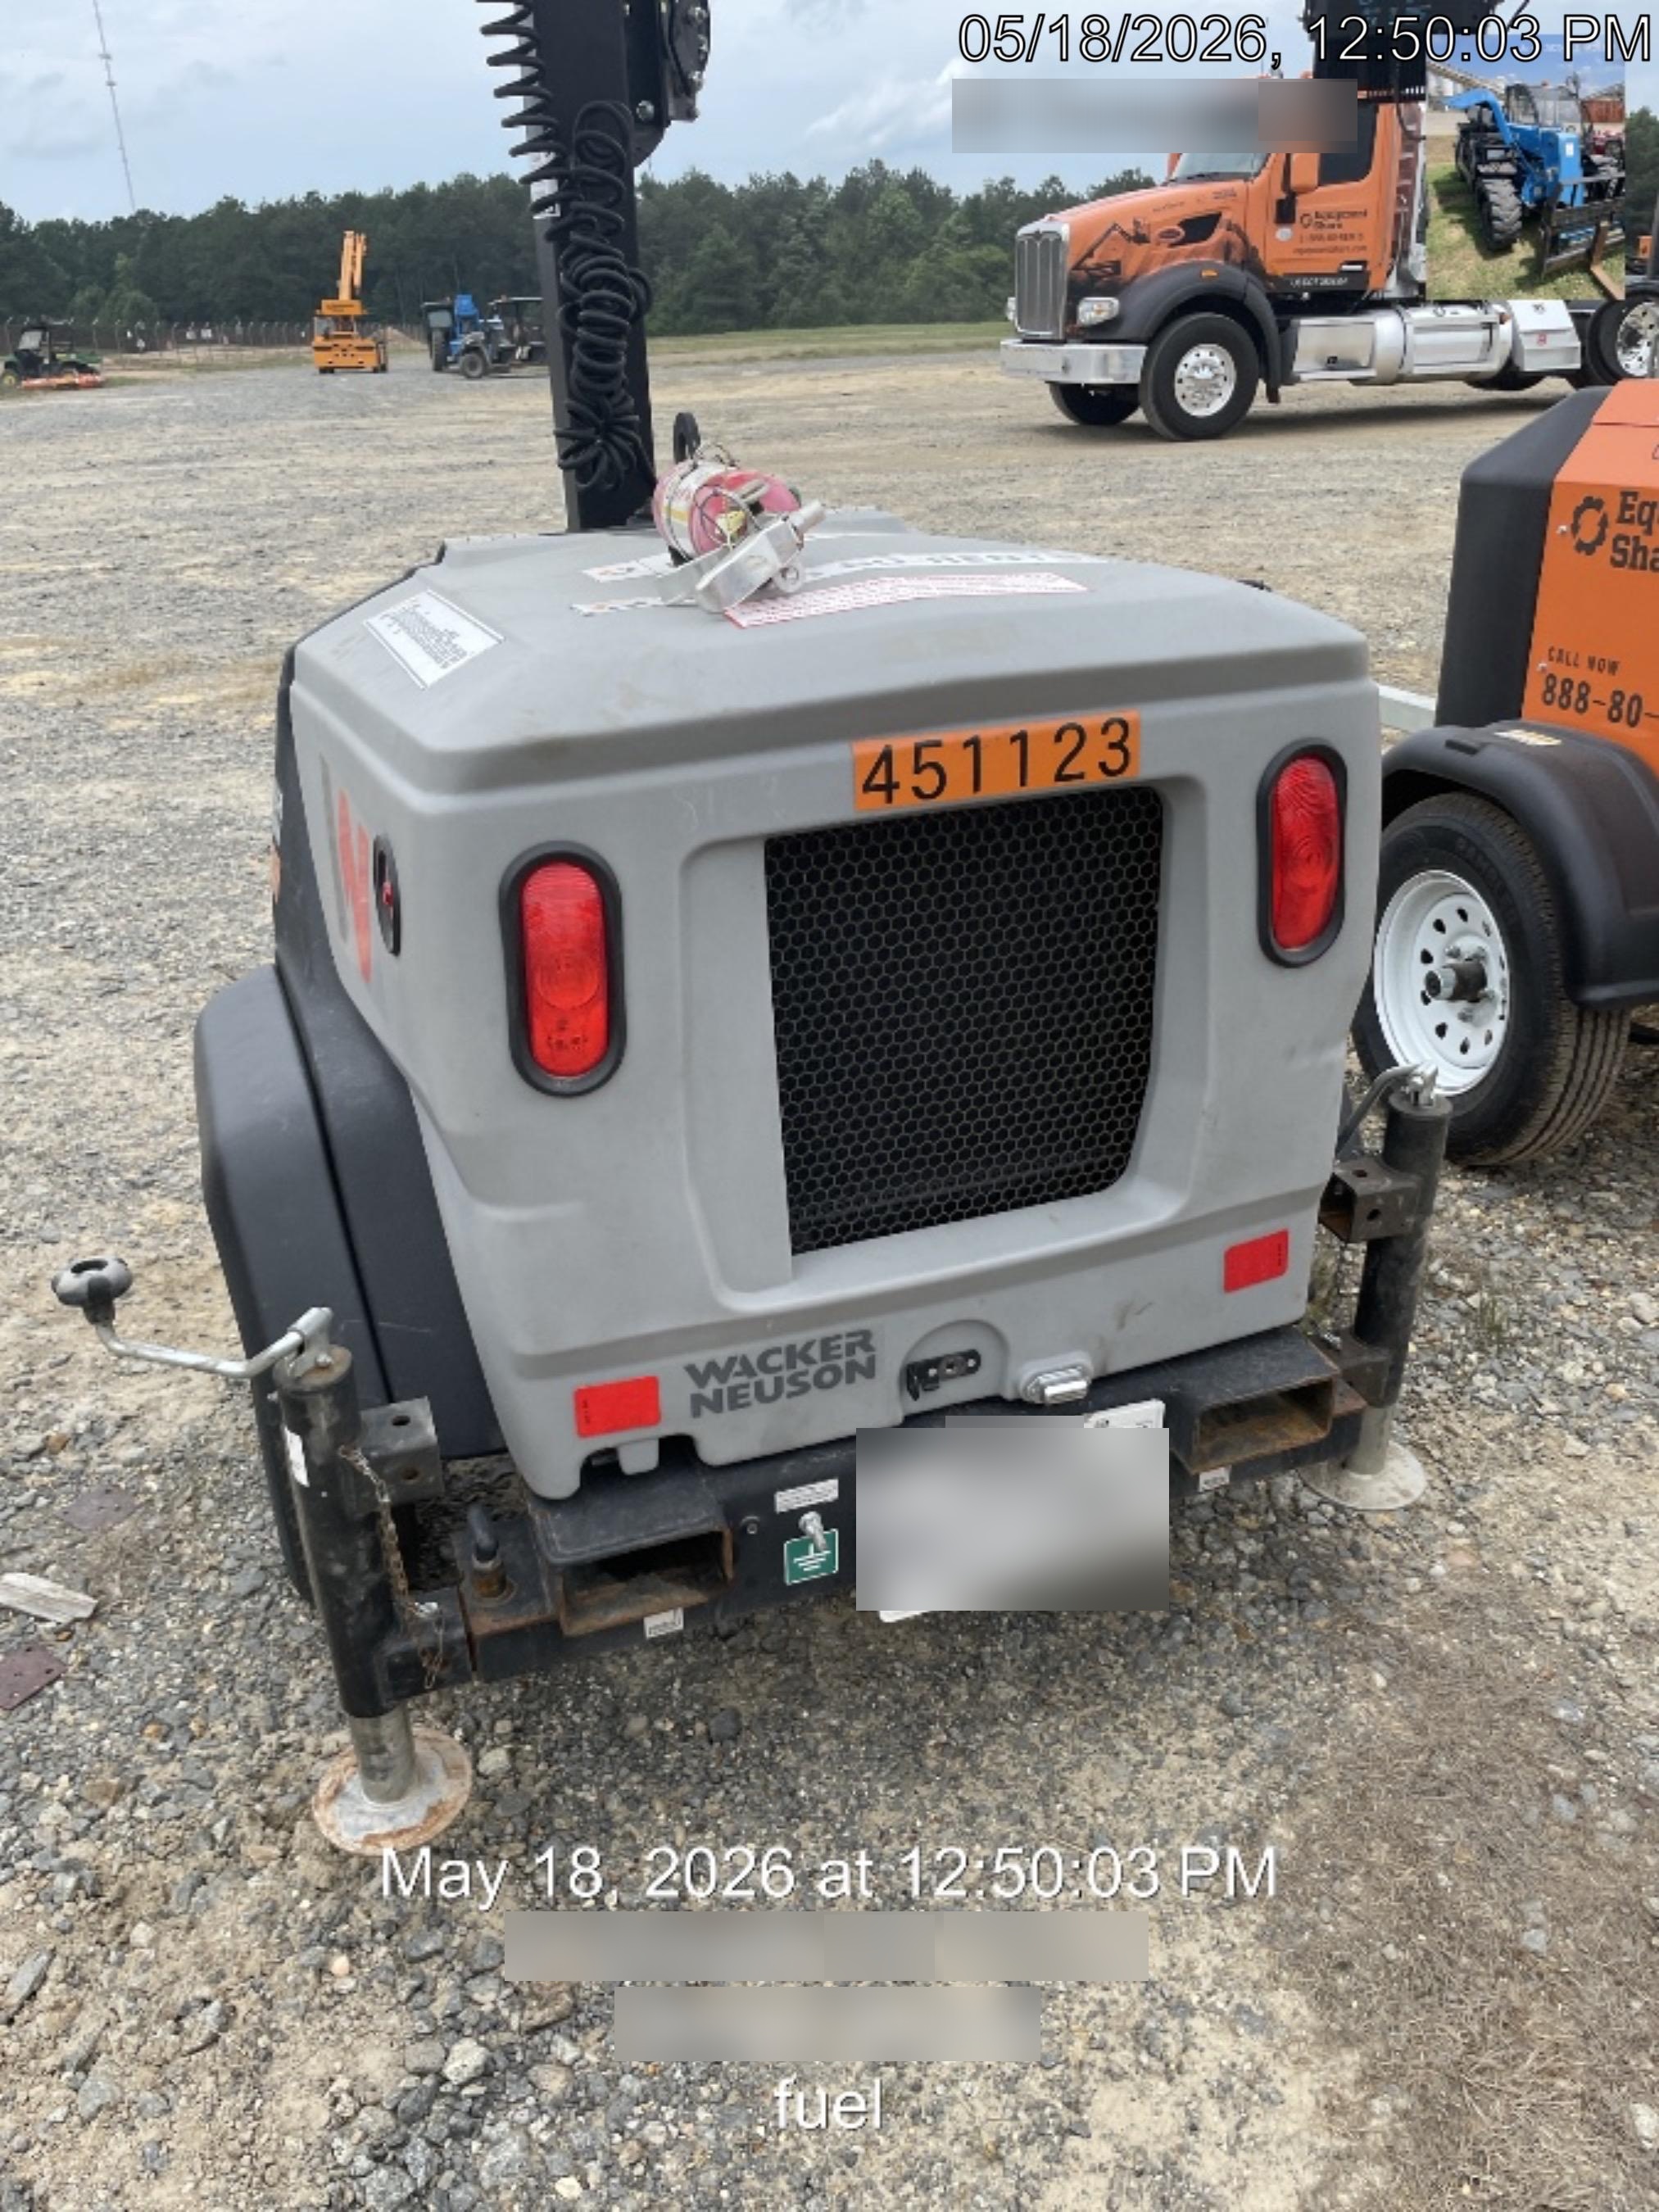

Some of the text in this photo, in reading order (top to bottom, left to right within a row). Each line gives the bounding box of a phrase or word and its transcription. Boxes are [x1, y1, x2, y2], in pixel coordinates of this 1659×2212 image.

[1615, 490, 1659, 537] Eq
[1610, 533, 1659, 573] Sha
[1548, 646, 1620, 676] CALL NOW
[862, 717, 1131, 805] 451123
[683, 1329, 876, 1389] WACKER
[690, 1354, 876, 1419] NEUSON
